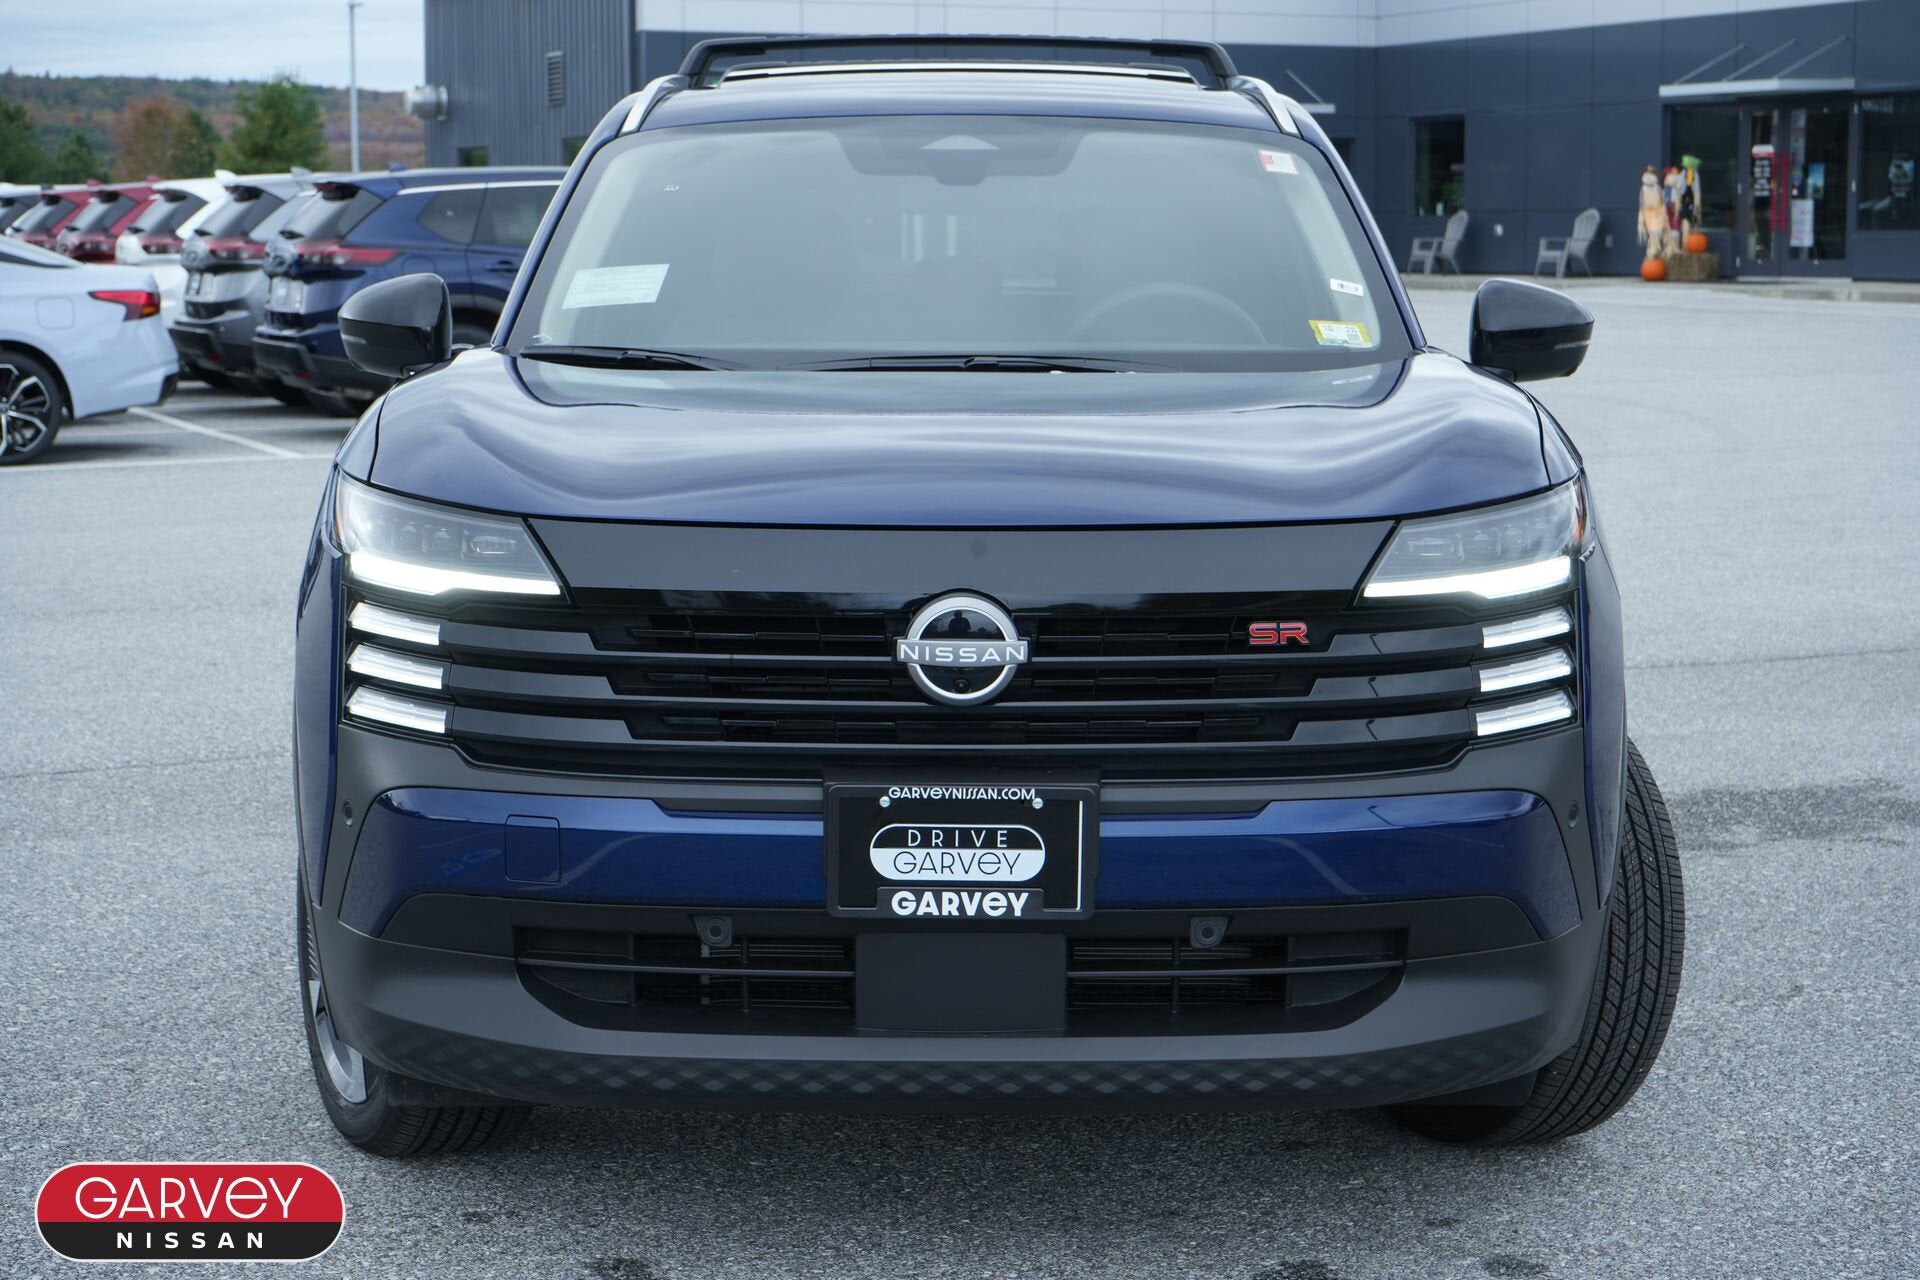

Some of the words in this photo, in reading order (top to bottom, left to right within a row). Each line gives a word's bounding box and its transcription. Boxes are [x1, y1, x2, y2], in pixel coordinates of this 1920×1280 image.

[1249, 622, 1309, 645] SR
[900, 643, 1025, 663] NISSAN
[907, 829, 1008, 848] DRIVE
